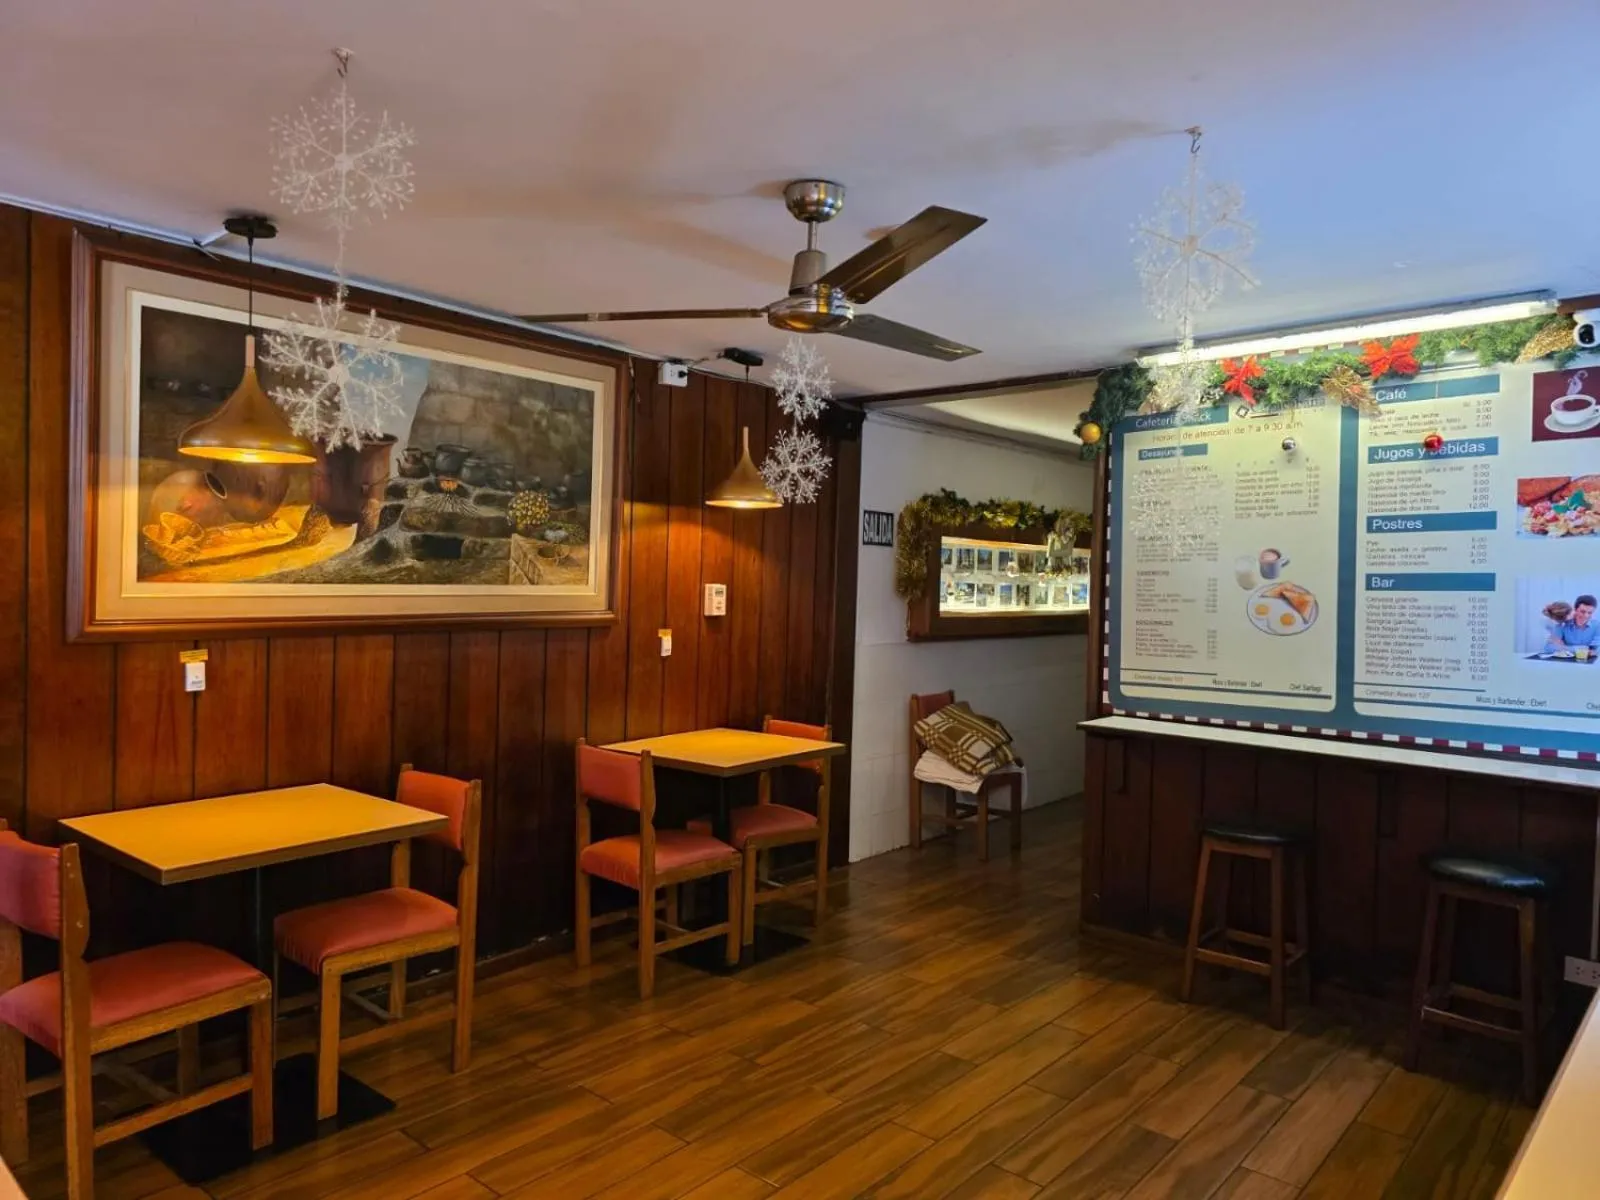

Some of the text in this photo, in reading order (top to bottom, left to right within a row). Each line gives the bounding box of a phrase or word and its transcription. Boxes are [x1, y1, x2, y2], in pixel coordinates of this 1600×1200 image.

[1375, 388, 1407, 401] Café
[1135, 413, 1180, 429] Cafeteri
[1374, 448, 1414, 460] Jugos
[1418, 447, 1426, 460] y
[864, 512, 893, 544] SALIDA
[1372, 518, 1423, 531] Postres
[1371, 576, 1395, 588] Bar
